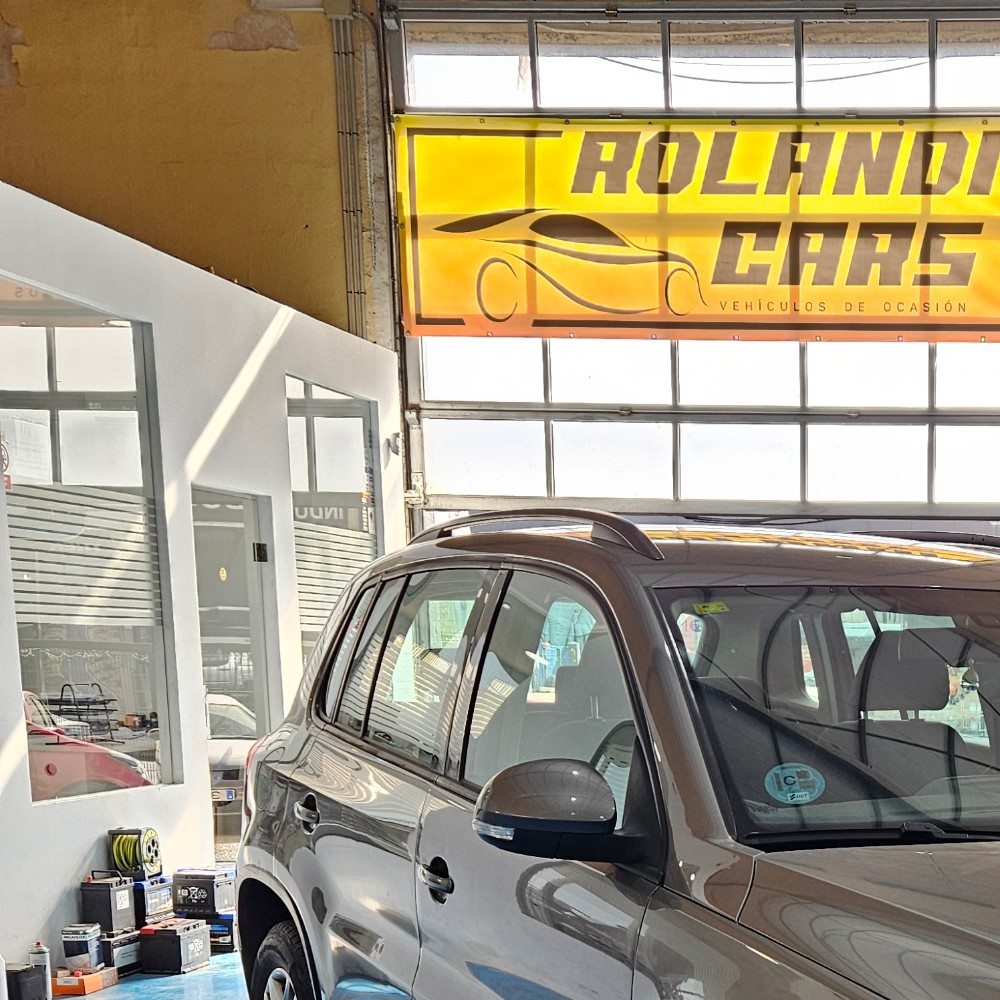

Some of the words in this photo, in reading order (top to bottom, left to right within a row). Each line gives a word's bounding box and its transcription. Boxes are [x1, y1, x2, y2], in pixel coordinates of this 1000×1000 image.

[711, 221, 984, 286] CARS
[719, 299, 826, 312] VEHÍCULOS
[845, 301, 865, 312] DE
[883, 299, 966, 313] OCASIÓN
